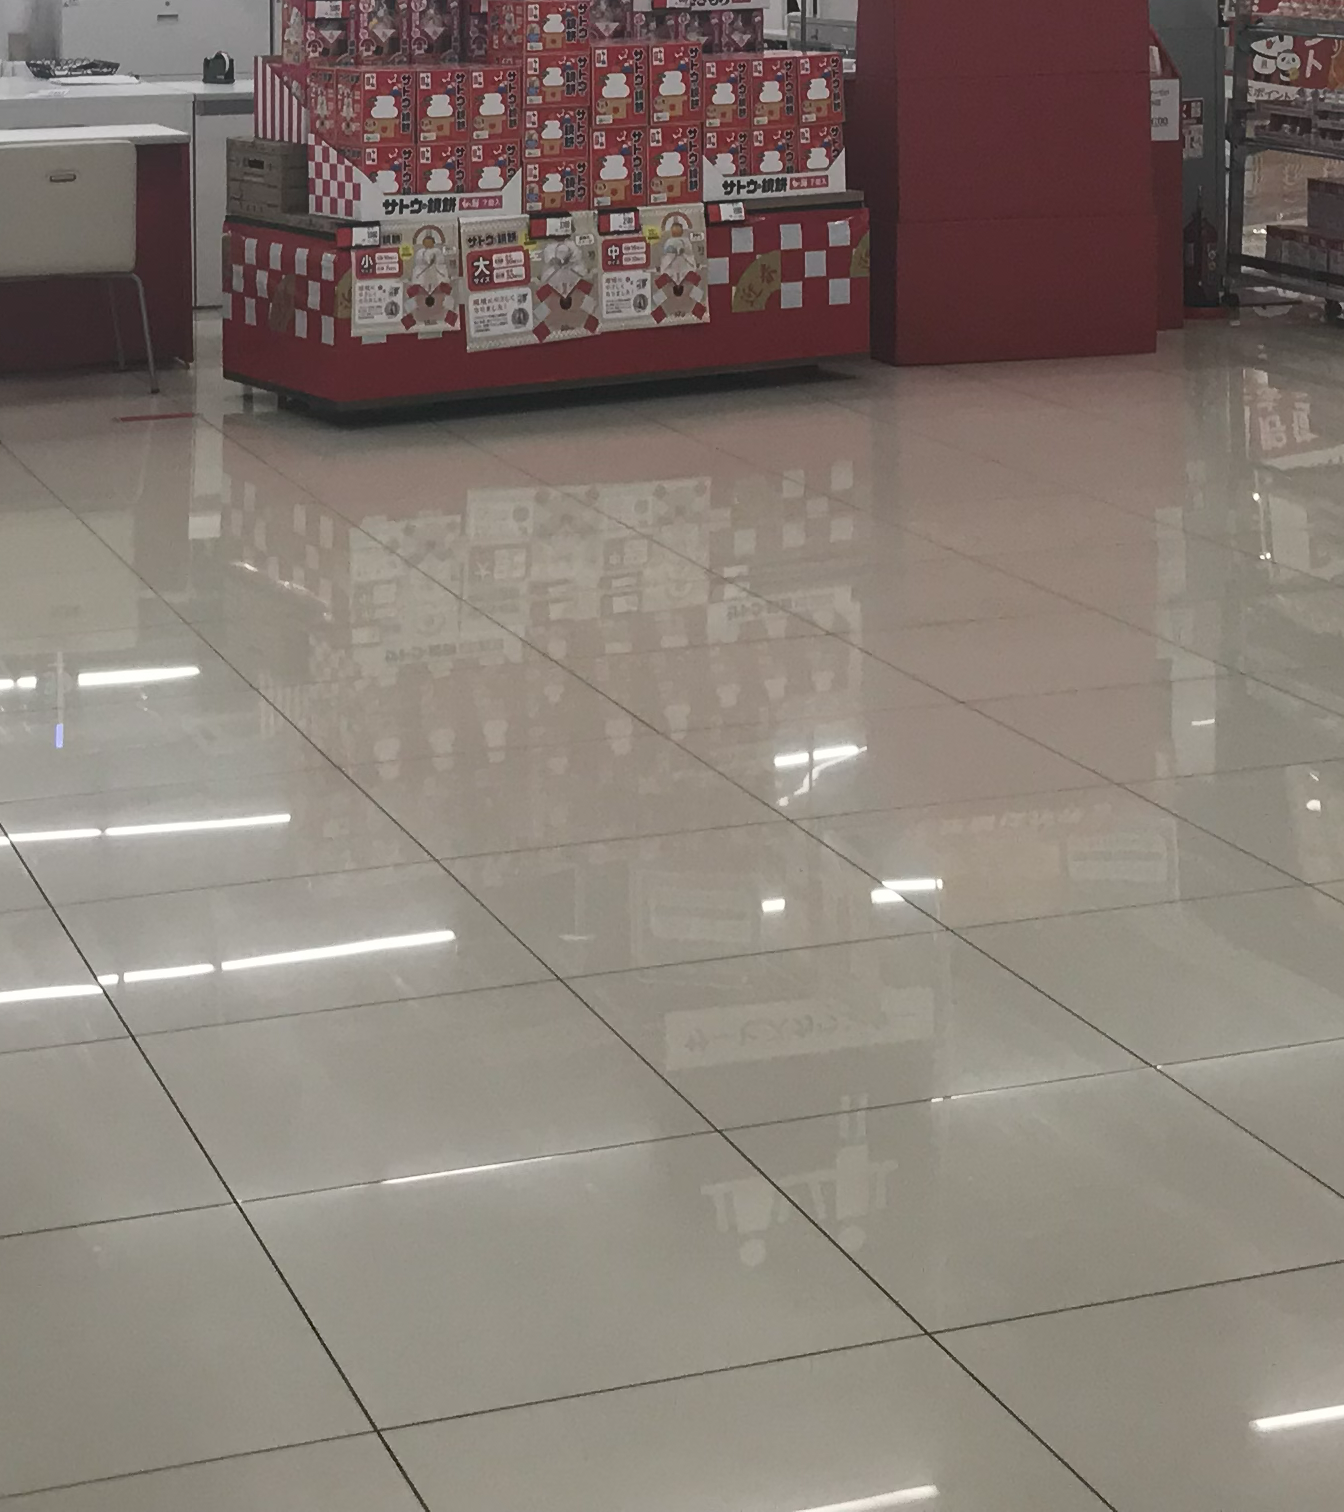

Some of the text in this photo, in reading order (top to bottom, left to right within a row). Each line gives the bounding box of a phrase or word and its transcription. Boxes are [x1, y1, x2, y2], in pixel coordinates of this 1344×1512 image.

[607, 244, 620, 260] 中
[360, 254, 373, 269] 小
[473, 257, 490, 276] 大
